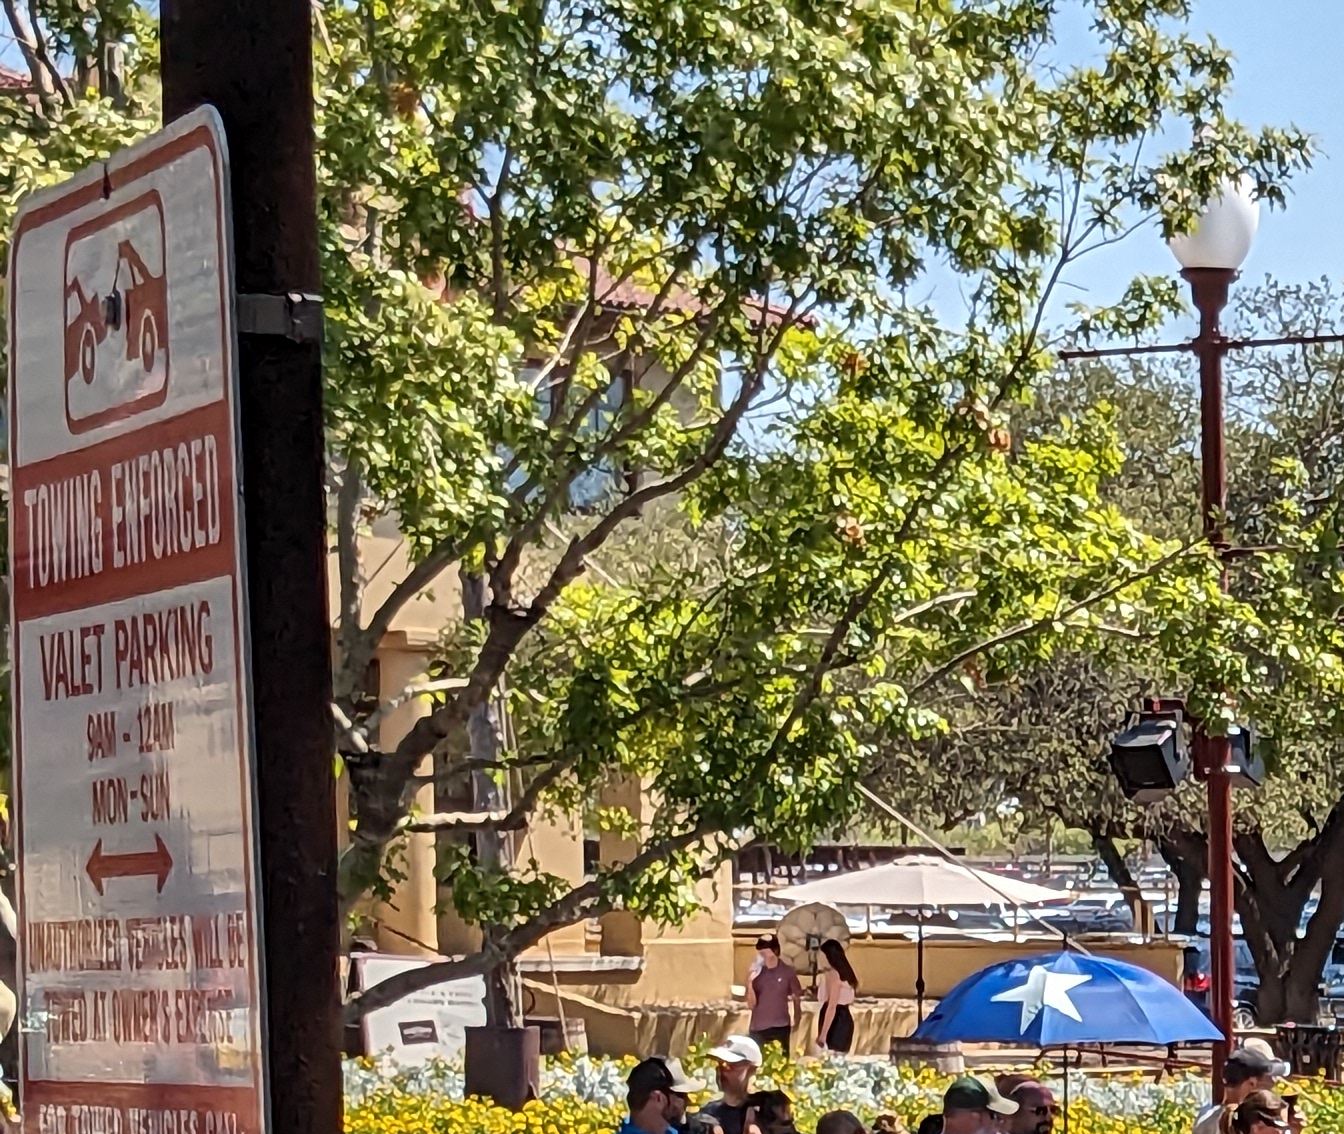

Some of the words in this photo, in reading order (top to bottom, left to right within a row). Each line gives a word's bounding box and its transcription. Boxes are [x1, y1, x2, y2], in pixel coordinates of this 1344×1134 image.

[24, 469, 103, 589] TOWING
[111, 434, 221, 568] ENFORCED
[40, 624, 105, 700] VALET
[114, 600, 213, 689] PARKING
[87, 711, 117, 762] 9AM
[137, 701, 175, 753] 12AM
[92, 771, 170, 825] MON-SUN
[93, 989, 107, 1042] AT
